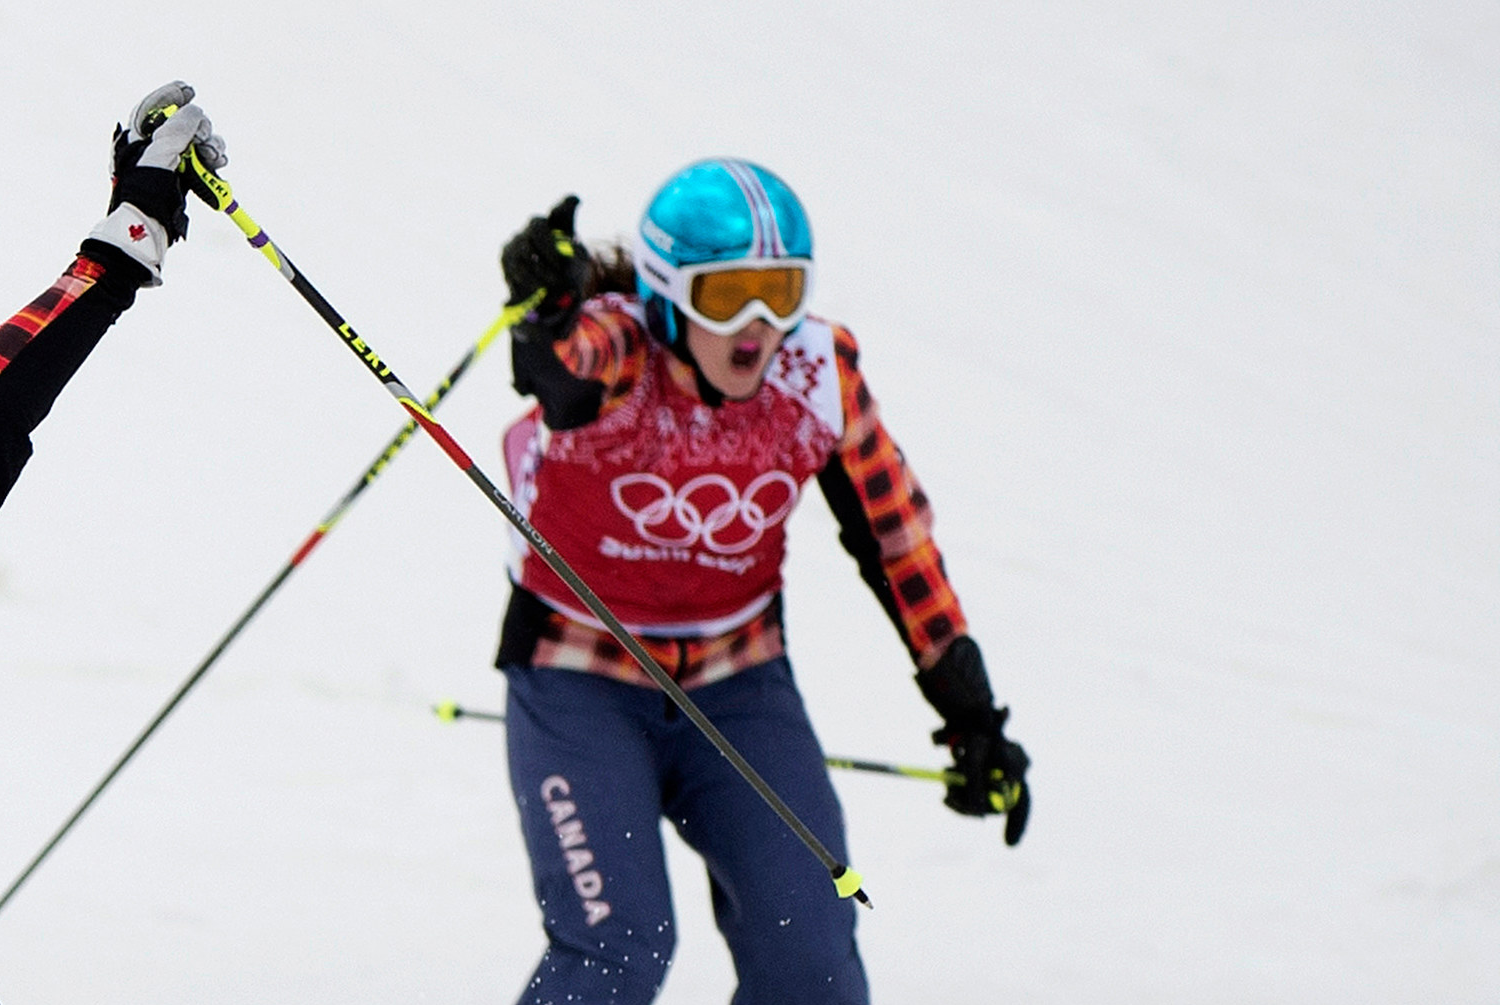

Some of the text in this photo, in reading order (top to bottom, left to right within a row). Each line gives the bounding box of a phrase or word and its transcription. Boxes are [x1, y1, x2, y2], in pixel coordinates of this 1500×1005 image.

[202, 172, 229, 198] LEKI
[338, 322, 391, 377] LEKI
[540, 774, 612, 928] CANADA
